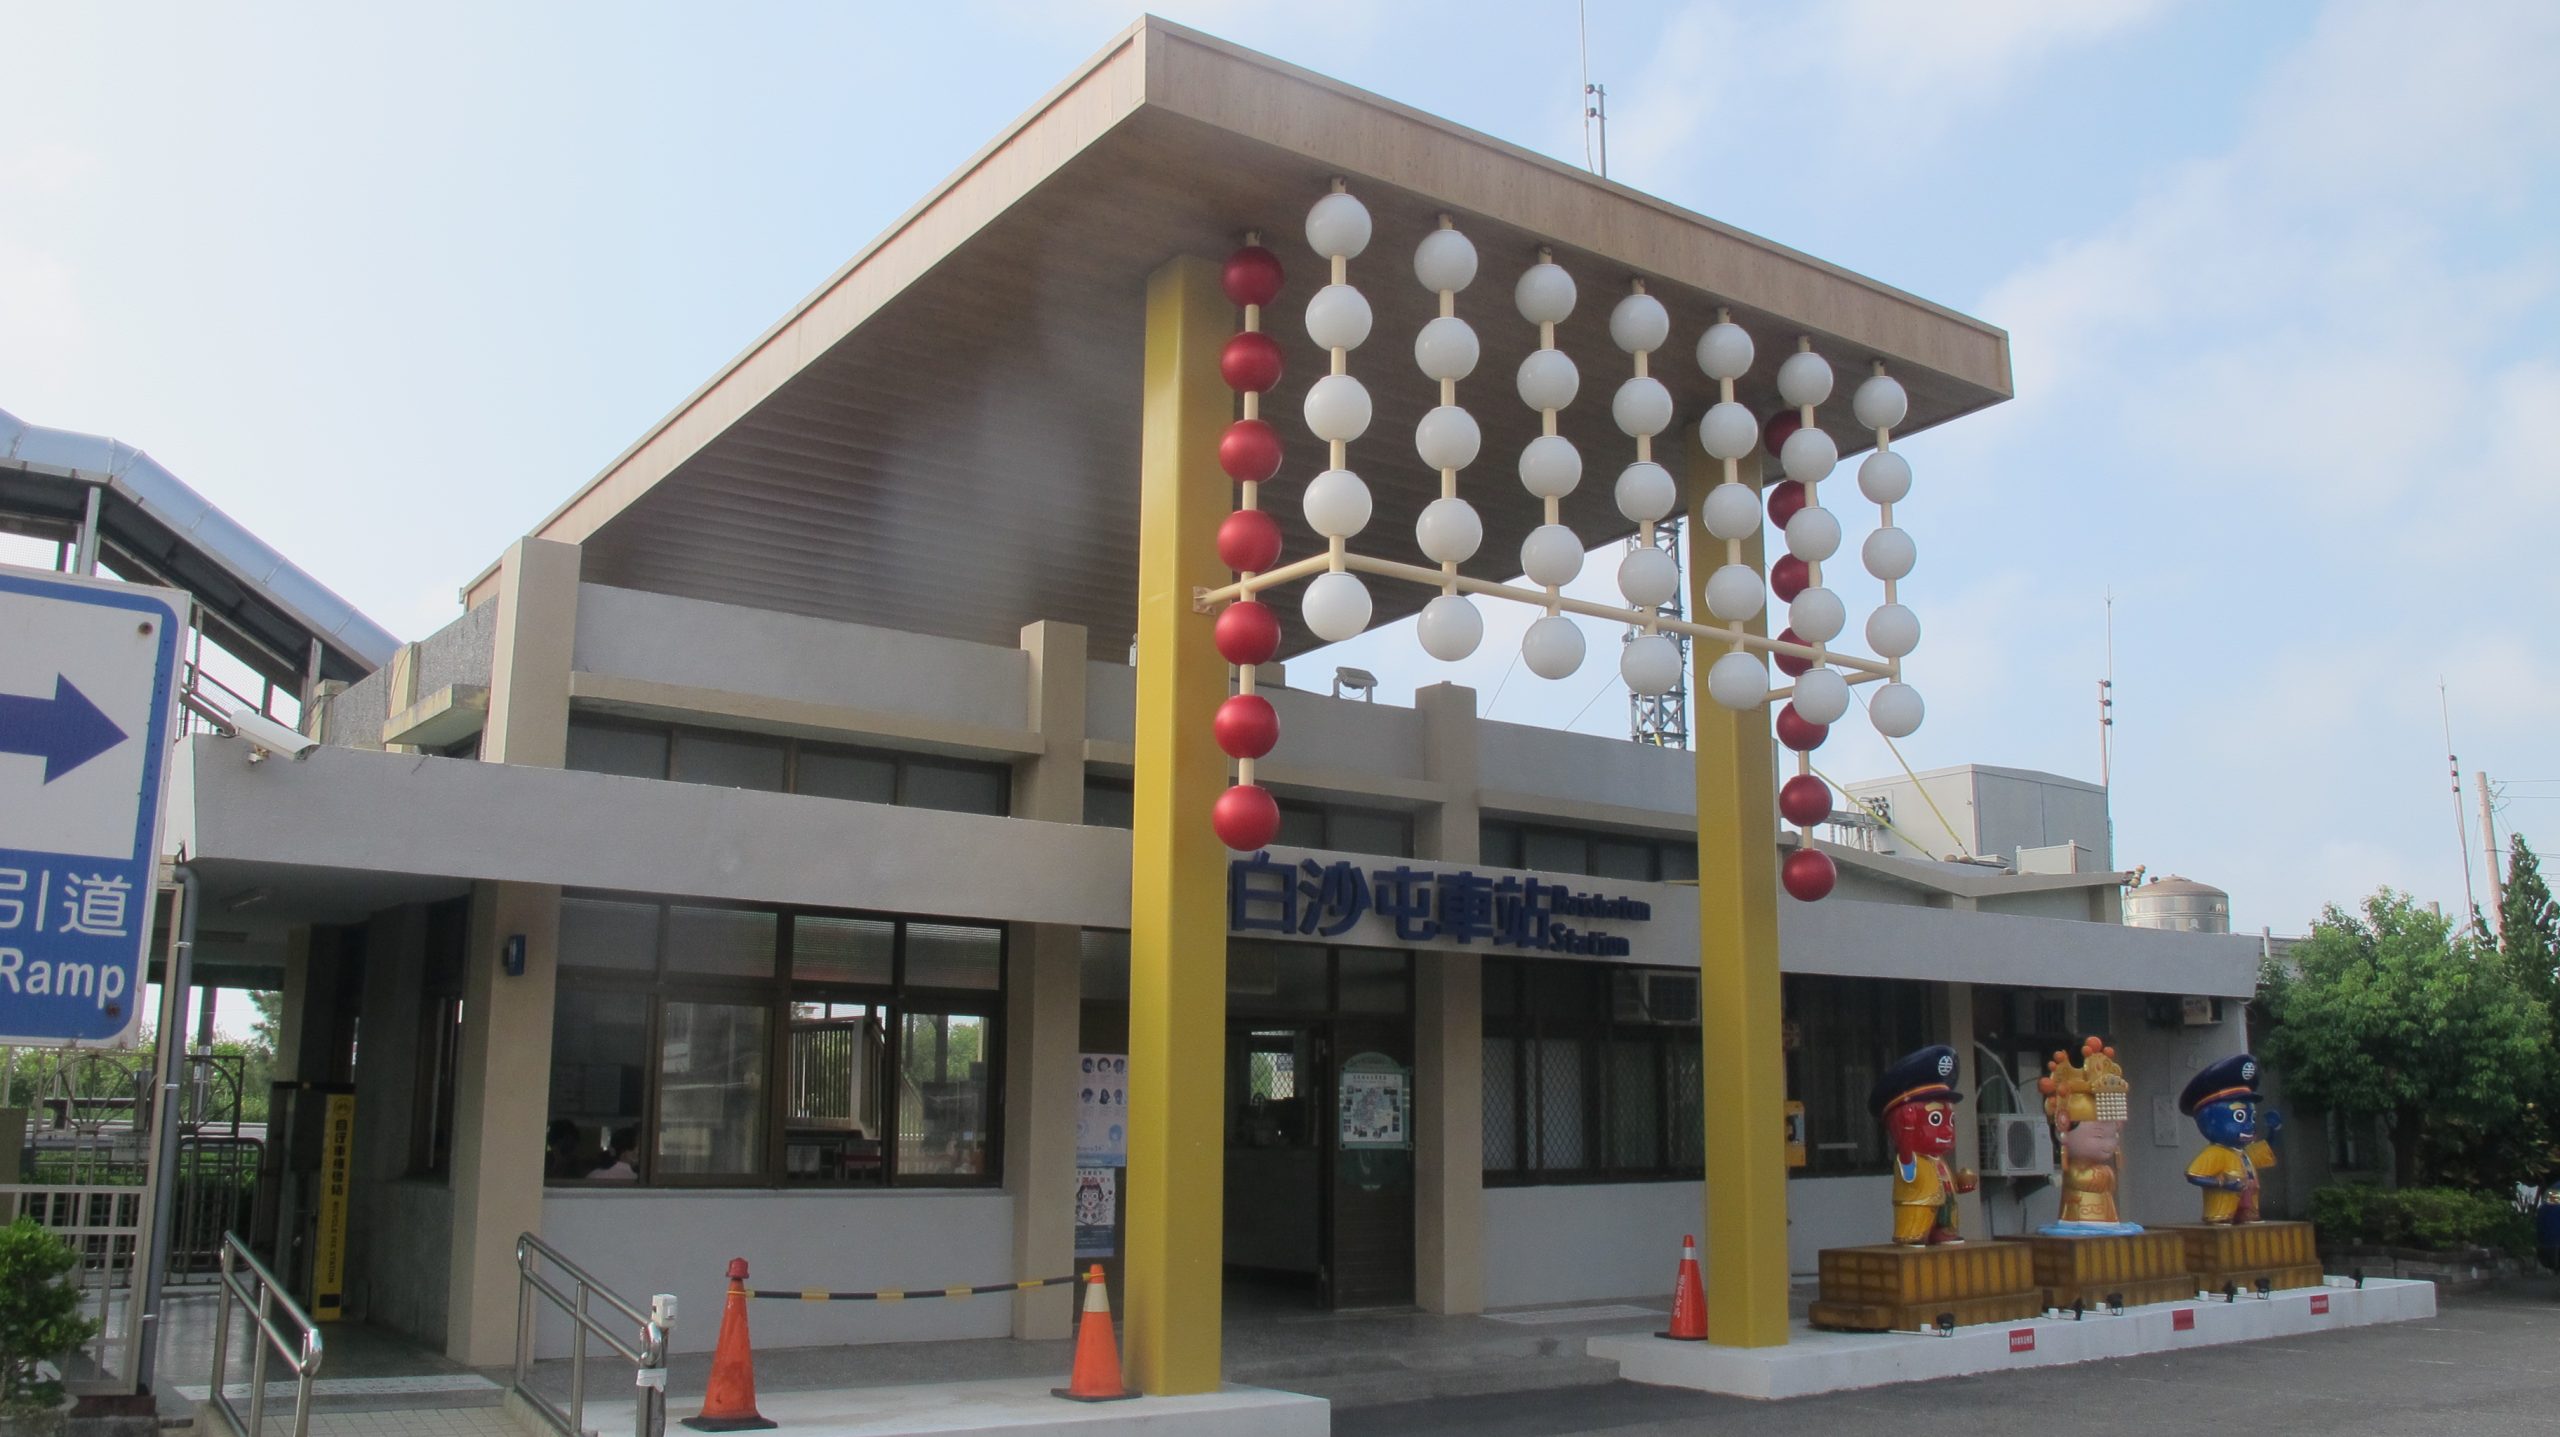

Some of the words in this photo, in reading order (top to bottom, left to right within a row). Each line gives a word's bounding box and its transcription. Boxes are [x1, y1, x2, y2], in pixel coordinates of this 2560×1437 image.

[0, 868, 132, 936] 引道
[1230, 851, 1550, 950] 白沙屯車站
[1551, 885, 1651, 921] Baishatun
[1549, 922, 1630, 956] Station
[0, 947, 125, 1009] Ramp
[328, 1249, 337, 1283] STATION
